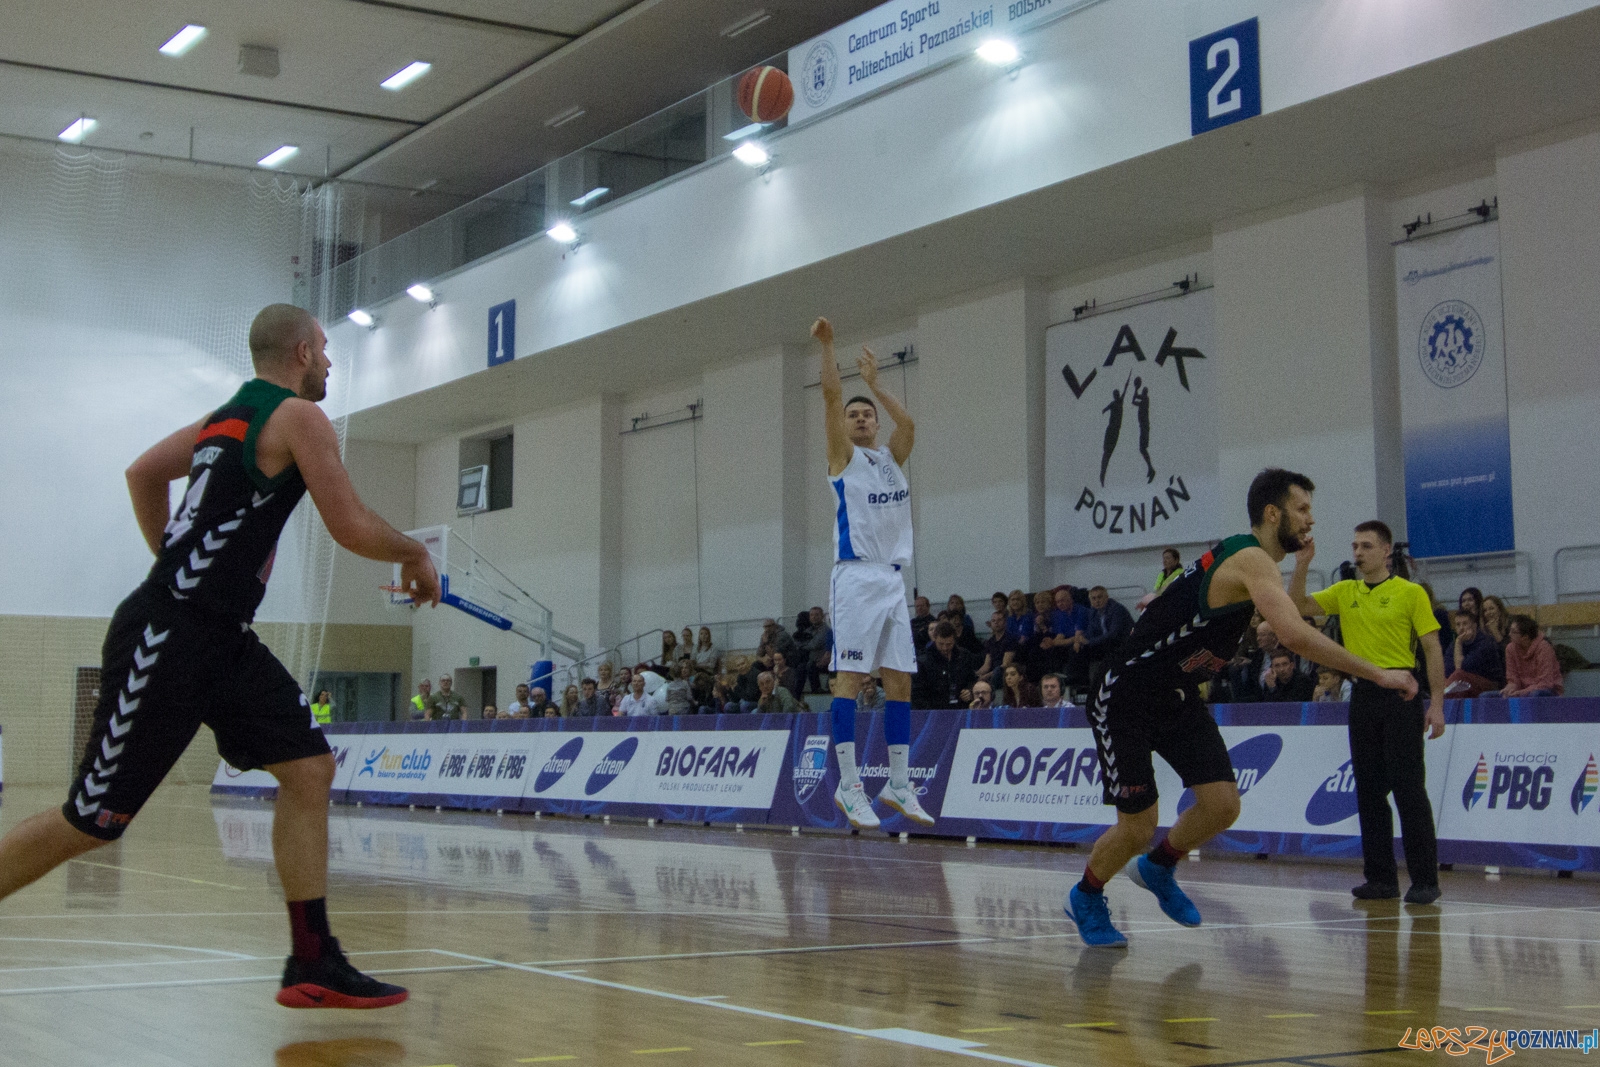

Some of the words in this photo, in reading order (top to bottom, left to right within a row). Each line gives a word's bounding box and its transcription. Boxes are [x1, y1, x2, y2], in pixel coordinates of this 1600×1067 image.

[848, 21, 897, 54] Centrum
[900, 0, 941, 32] Sportu
[848, 40, 915, 85] Politechniki
[919, 5, 994, 54] Poznańskiej
[1207, 37, 1241, 118] 2
[495, 310, 504, 358] 1
[1074, 474, 1191, 534] POZNAŃ
[847, 650, 863, 661] PBG
[445, 754, 467, 778] PBG
[473, 754, 496, 779] PBG
[503, 755, 526, 780] PBG
[544, 756, 571, 774] atrem
[595, 757, 624, 775] atrem
[655, 745, 761, 778] BIOFARM
[1494, 752, 1558, 765] fundacja
[377, 770, 396, 778] biuro
[660, 782, 680, 791] POLSKI
[682, 783, 719, 792] PRODUCENT
[979, 792, 1010, 803] POLSKI
[1014, 793, 1070, 805] PRODUCENT
[1487, 765, 1555, 811] PBG
